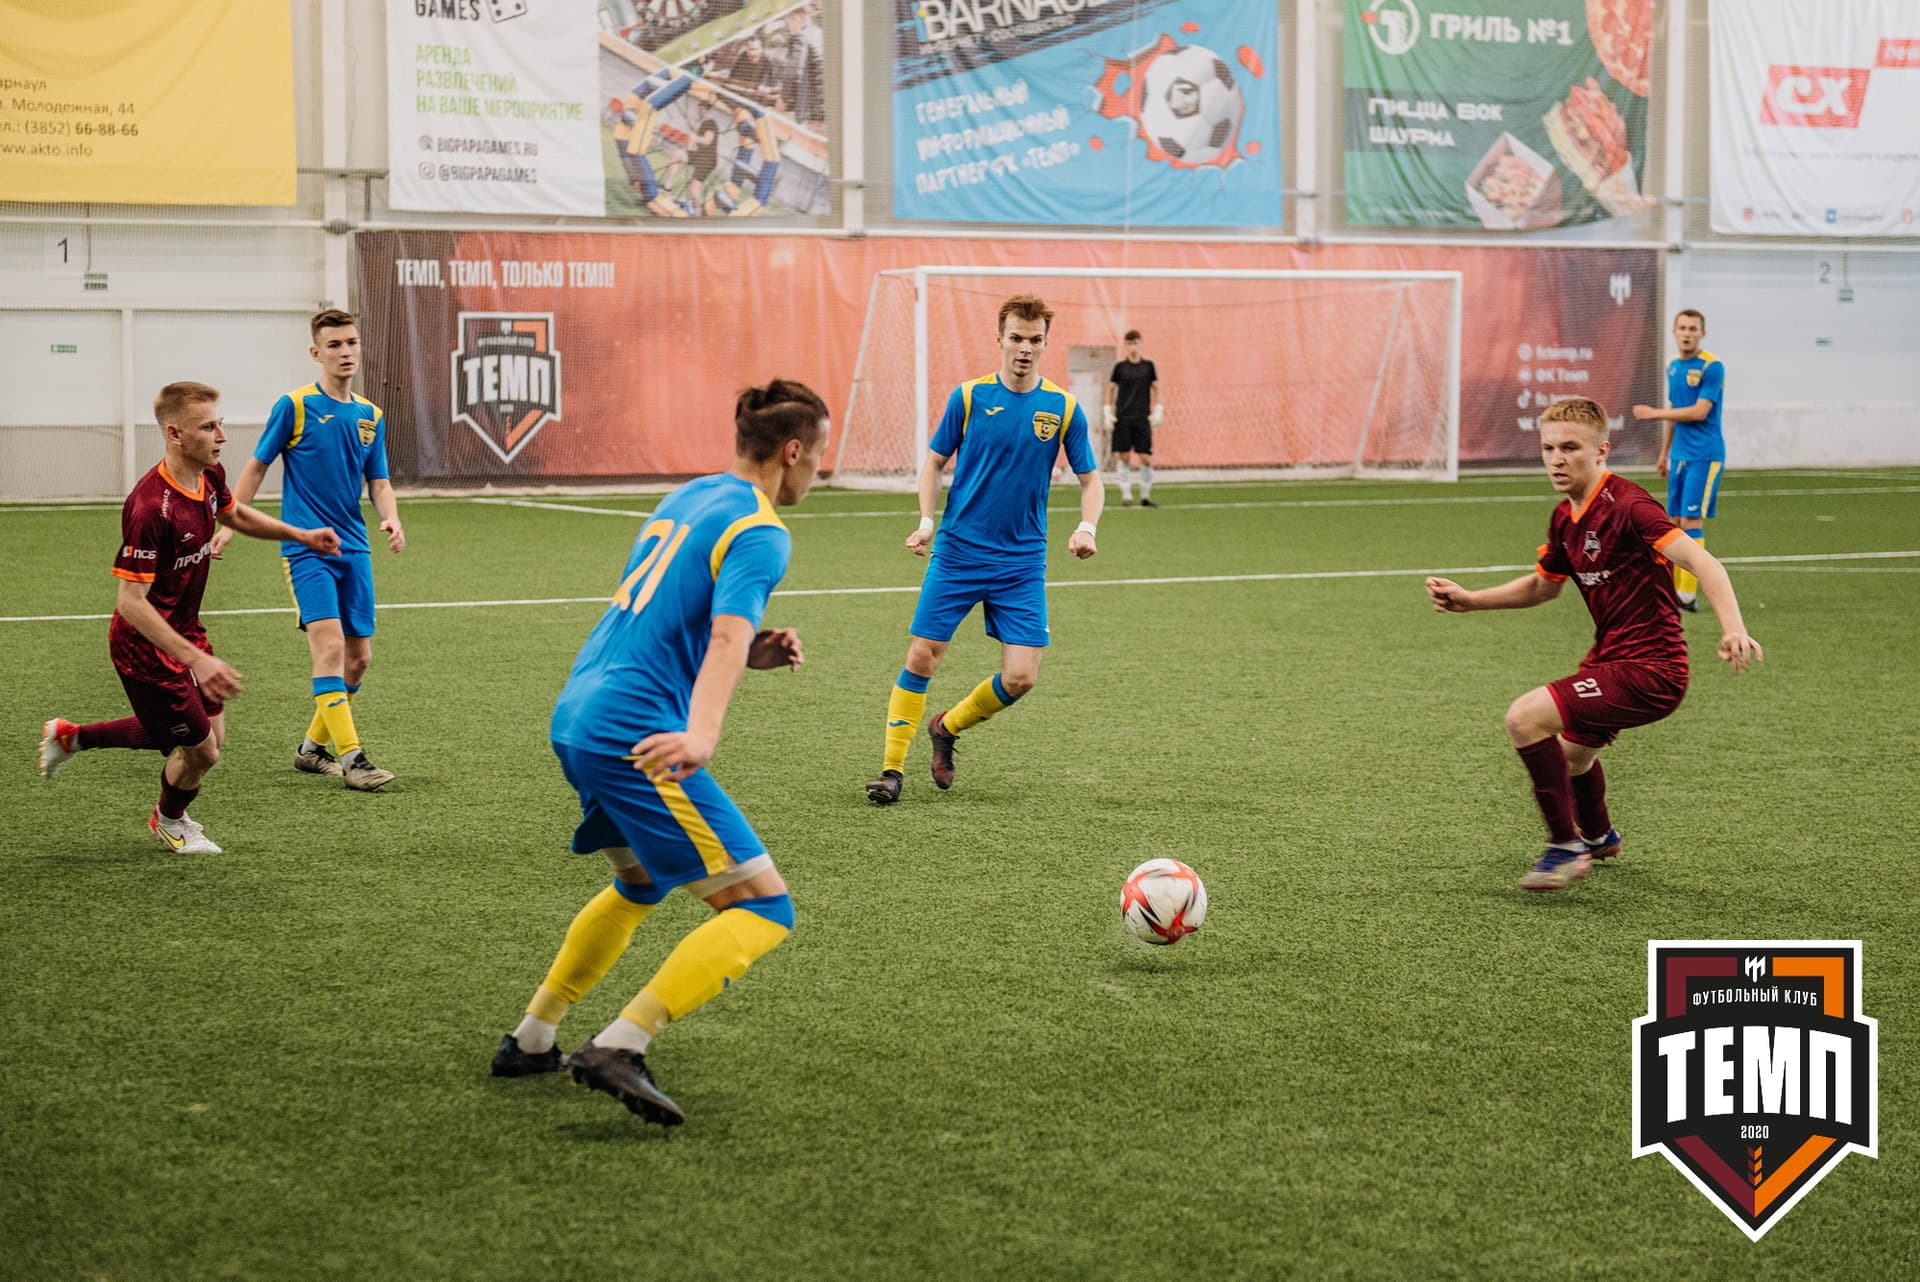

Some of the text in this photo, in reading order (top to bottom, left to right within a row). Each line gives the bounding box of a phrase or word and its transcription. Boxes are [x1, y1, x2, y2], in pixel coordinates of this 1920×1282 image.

[415, 0, 480, 21] GAMES
[1429, 12, 1574, 46] ГРИЛЬ №1
[415, 44, 472, 67] АРЕНДА
[415, 68, 518, 93] РАЗВЛЕЧЕНИЙ
[117, 102, 136, 115] 44
[415, 95, 584, 121] НА ВАШЕ МЕРОПРИЯТИЕ
[1368, 96, 1503, 122] ПИЦЦА ВОК
[25, 119, 71, 137] (3852)
[75, 122, 140, 137] 66-88-66
[1368, 125, 1456, 147] ШАУРМА
[0, 142, 94, 157] ww.akto.info
[916, 159, 989, 195] ПАРТНЕР
[57, 237, 68, 264] 1
[396, 258, 616, 290] ТЕМП, ТЕМП, ТОЛЬКО ТЕМП!
[1819, 261, 1832, 284] 2
[462, 354, 551, 406] ТЕМП
[133, 548, 157, 560] ПСБ
[610, 518, 691, 615] 21
[1571, 677, 1602, 698] 27
